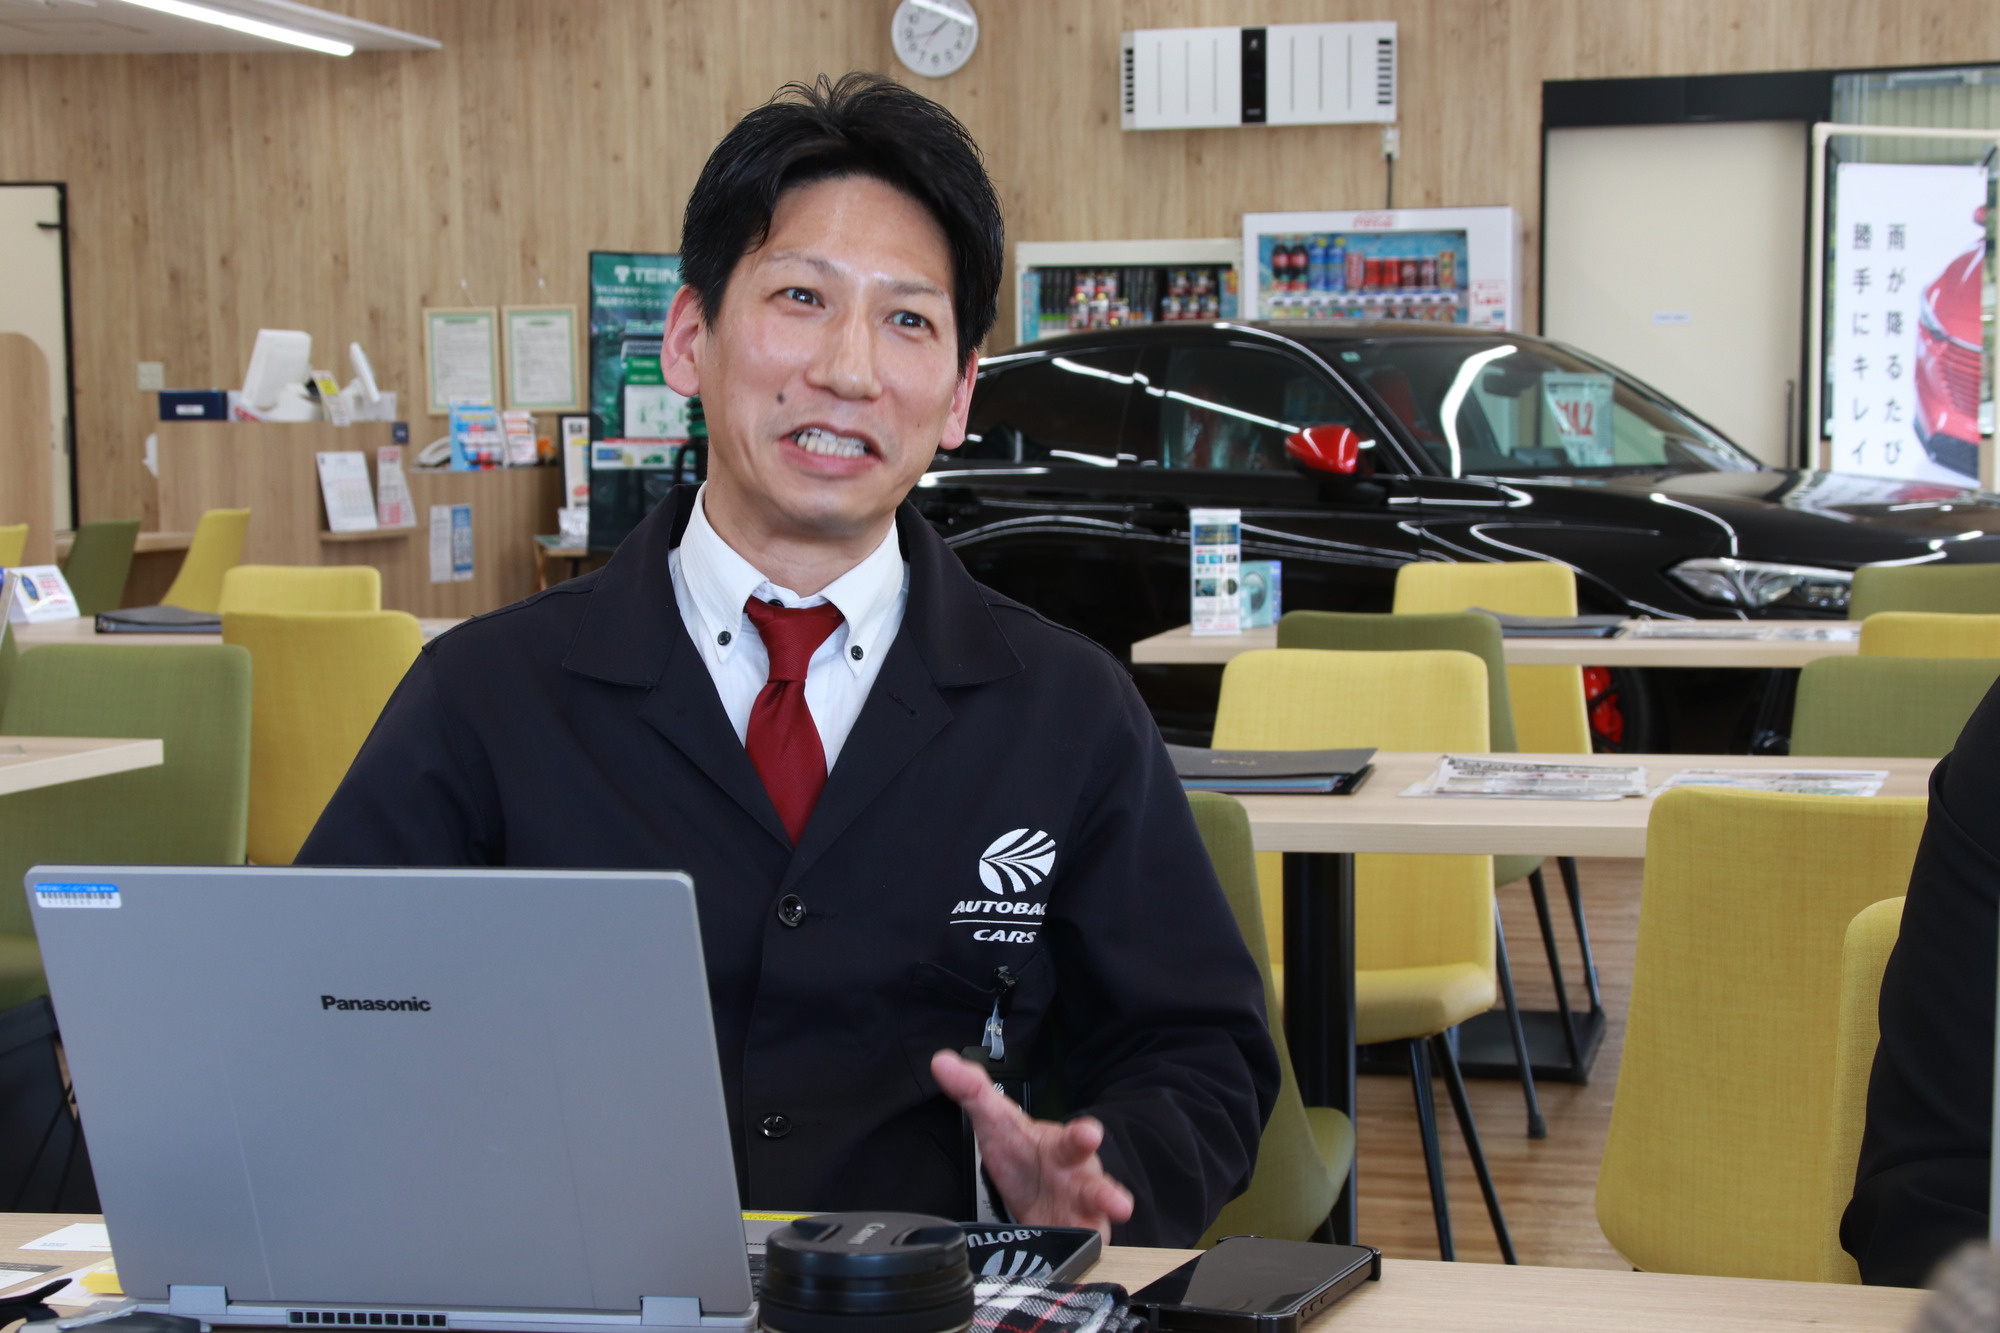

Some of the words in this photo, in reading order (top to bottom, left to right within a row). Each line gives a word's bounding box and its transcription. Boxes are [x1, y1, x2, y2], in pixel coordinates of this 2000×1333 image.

[1852, 222, 1873, 467] 勝手にキレイ
[1884, 223, 1906, 465] 雨が降るたび
[973, 929, 1037, 944] CARS
[320, 995, 431, 1012] Panasonic
